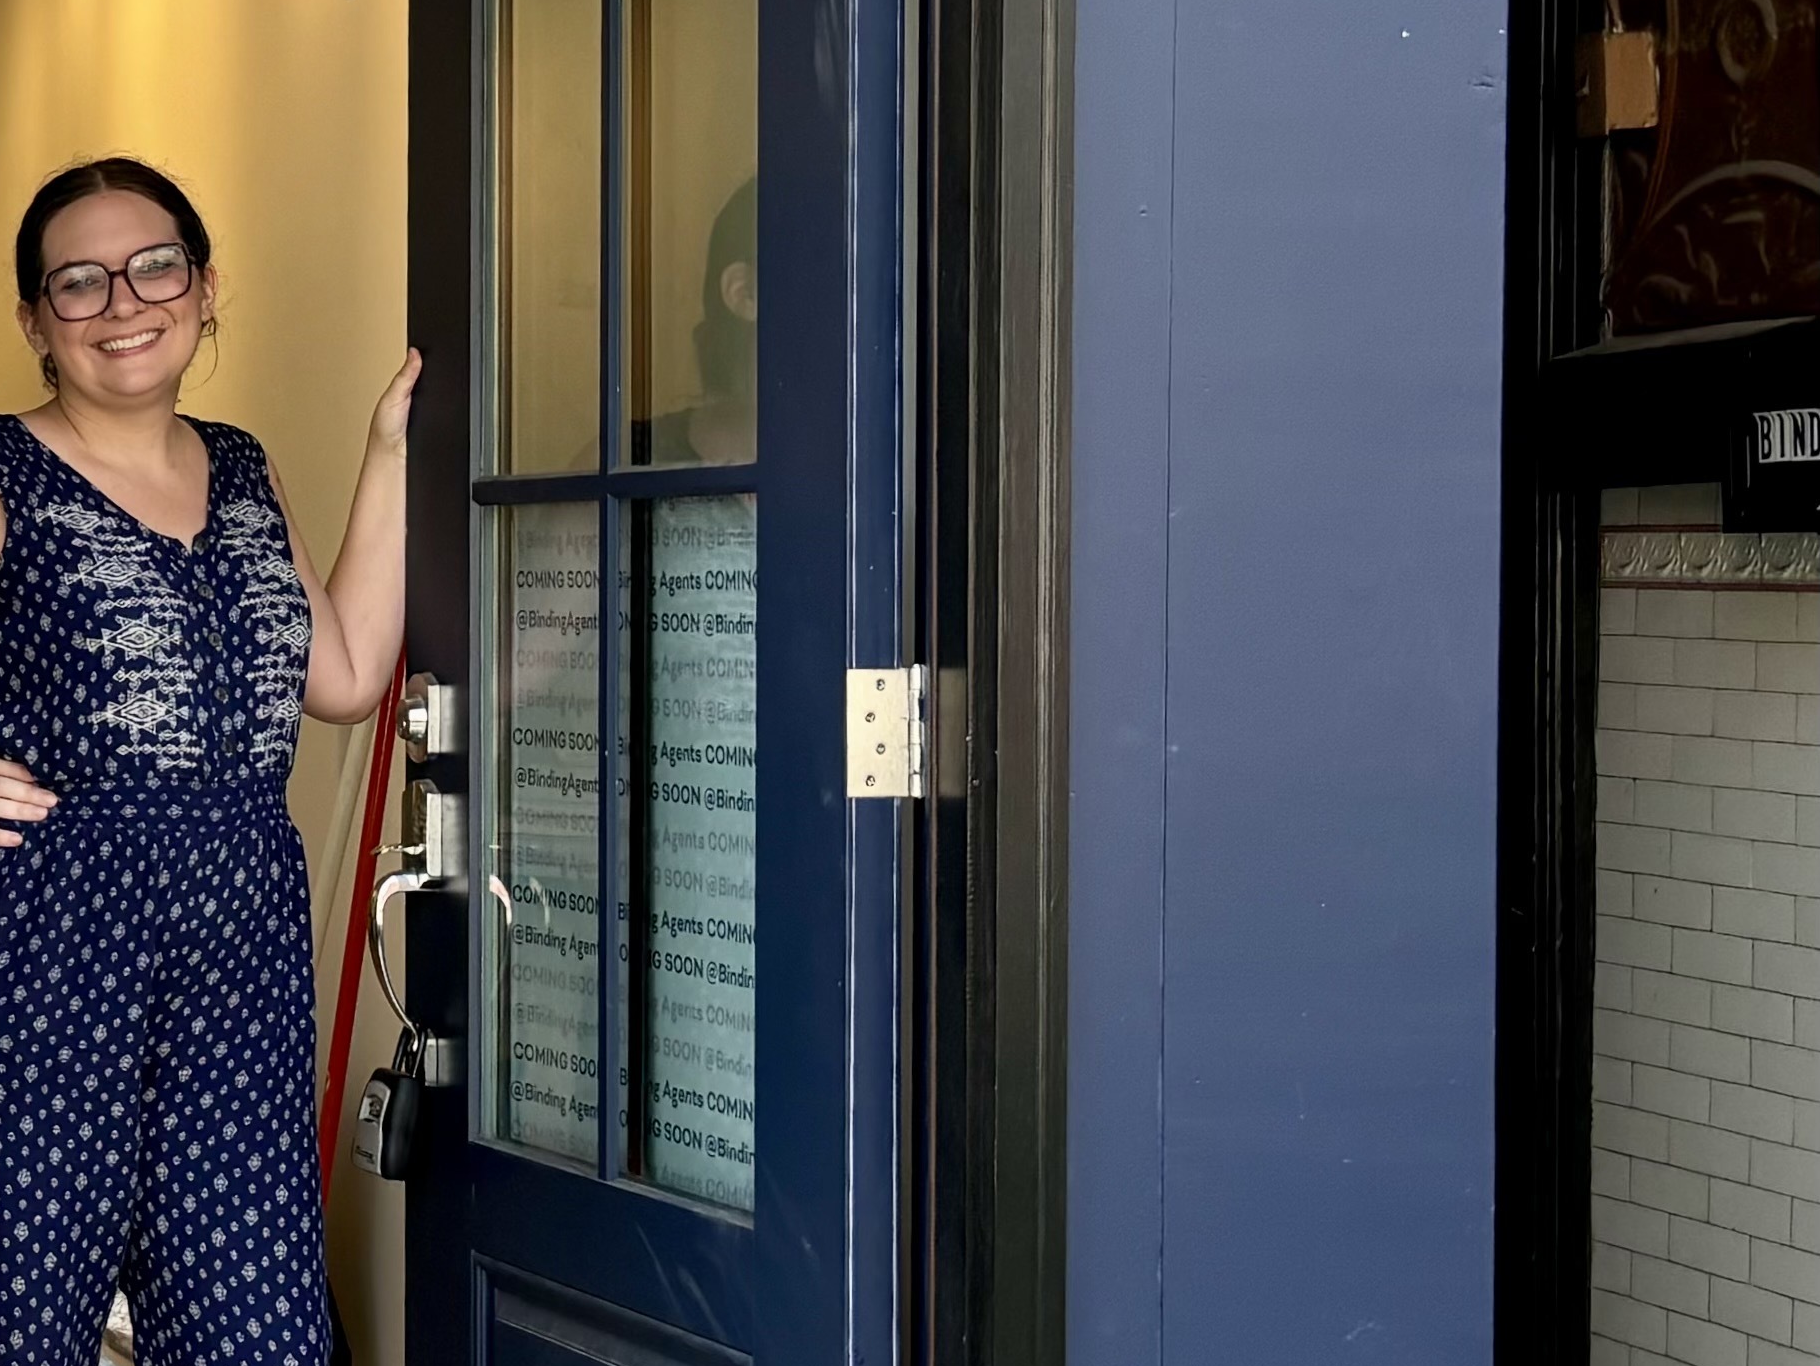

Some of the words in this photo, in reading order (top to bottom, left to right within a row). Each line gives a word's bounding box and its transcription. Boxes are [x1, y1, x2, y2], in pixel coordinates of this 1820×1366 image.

[516, 570, 565, 588] COMING
[659, 570, 701, 598] Agents
[661, 612, 701, 633] SOON
[703, 612, 754, 636] @Bindin
[512, 727, 566, 750] COMING
[659, 741, 702, 768] Agents
[661, 783, 701, 807] SOON
[703, 787, 754, 813] @Bindin
[660, 910, 703, 939] Agents
[568, 935, 599, 961] Agen
[664, 951, 704, 979] SOON
[706, 961, 754, 989] @Bindin
[513, 1041, 568, 1071] COMING
[570, 1056, 597, 1078] SOO
[568, 1094, 598, 1122] Agen
[661, 1079, 704, 1110] Agents
[706, 1091, 754, 1122] COMIN
[662, 1123, 702, 1149] SOON
[704, 1134, 755, 1165] @Bindin
